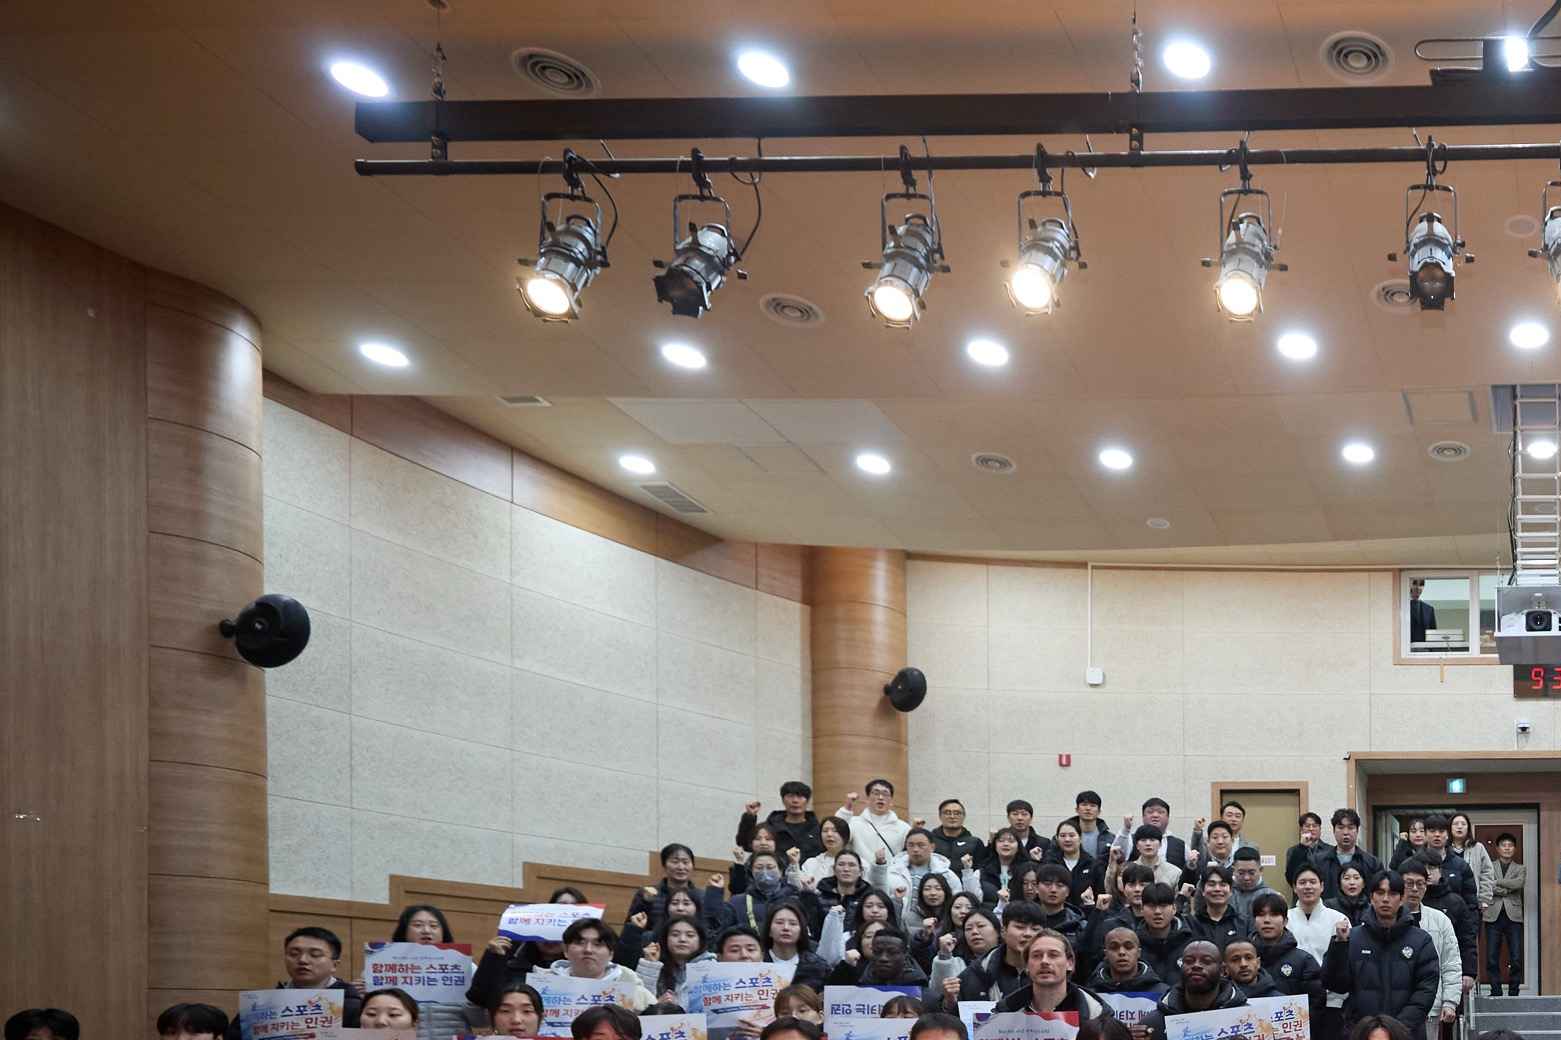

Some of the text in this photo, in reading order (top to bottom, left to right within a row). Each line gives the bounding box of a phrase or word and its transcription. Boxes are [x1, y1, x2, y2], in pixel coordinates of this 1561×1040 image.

[371, 963, 422, 975] 함께하는
[371, 975, 466, 987] 함께 지키는 인권
[734, 976, 773, 990] 스포츠
[574, 993, 616, 1006] 스포츠
[703, 996, 723, 1007] 함께
[724, 994, 753, 1005] 지키는
[280, 1002, 323, 1017] 스포츠
[271, 1021, 301, 1032] 지키는
[303, 1016, 334, 1031] 인권
[1217, 1022, 1255, 1038] 스포츠
[1282, 1021, 1304, 1034] 인권
